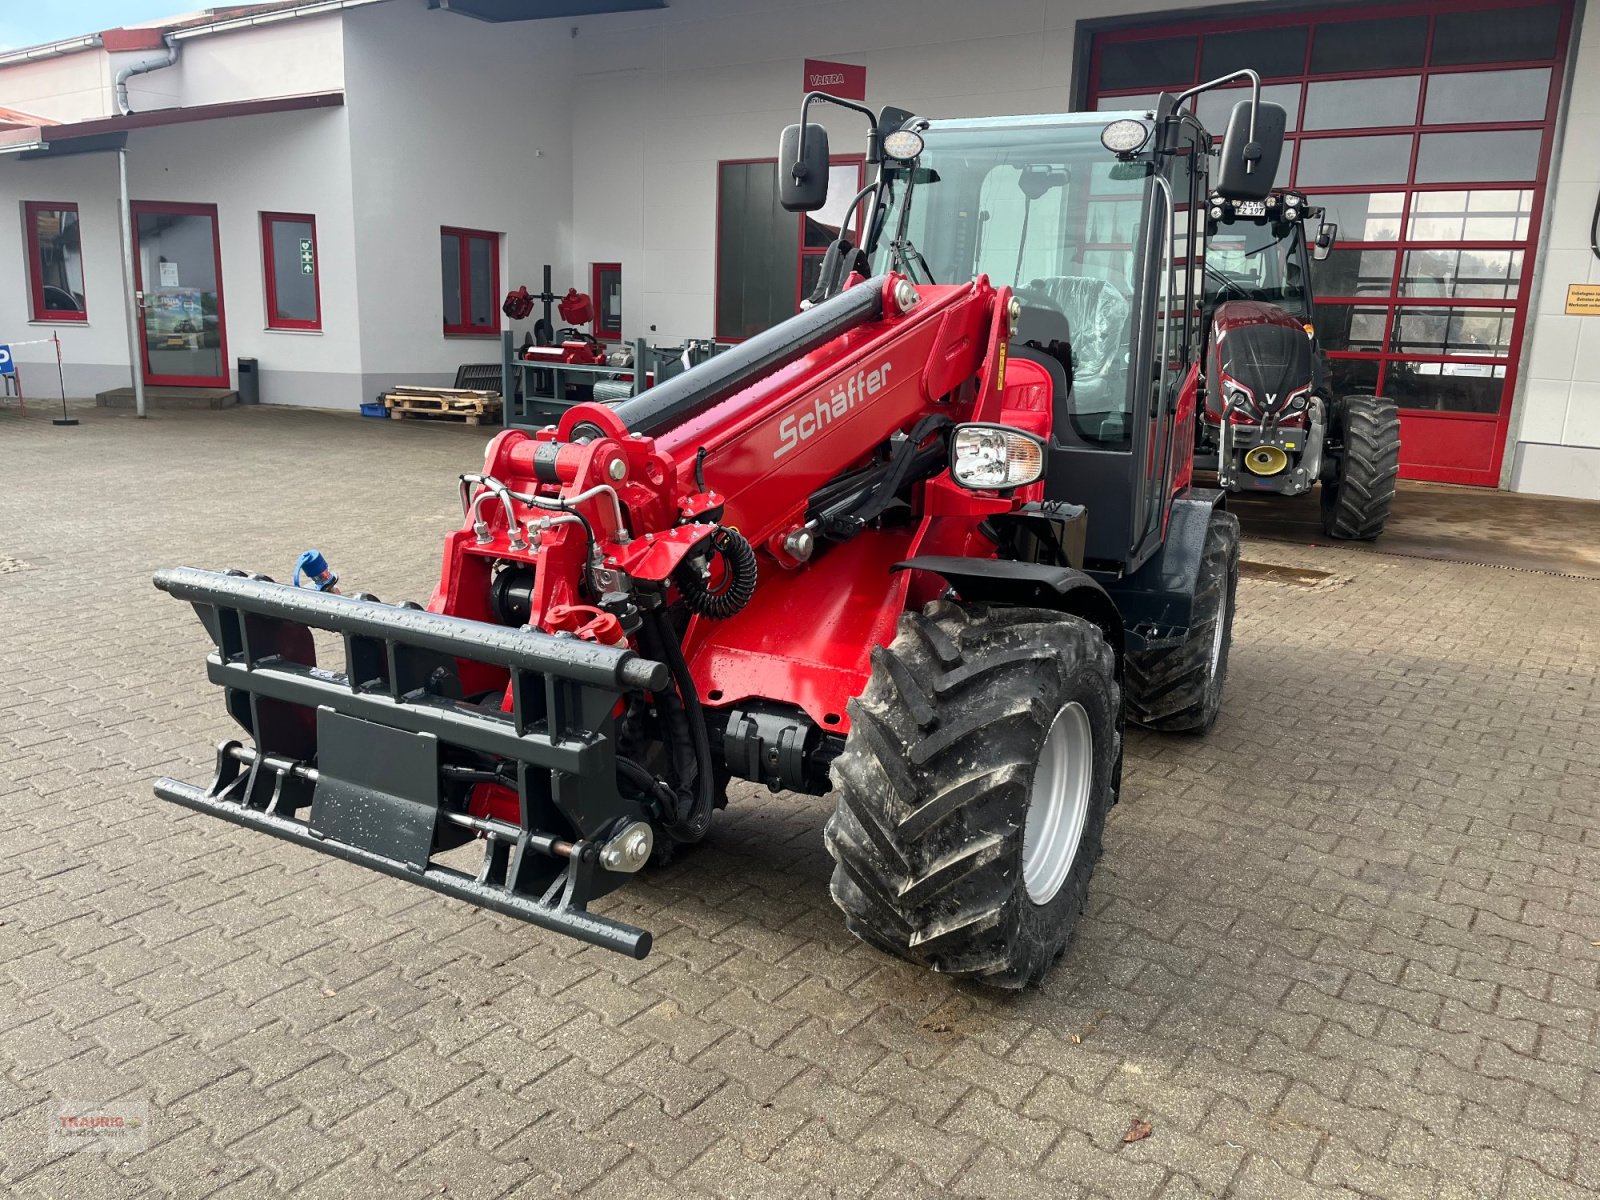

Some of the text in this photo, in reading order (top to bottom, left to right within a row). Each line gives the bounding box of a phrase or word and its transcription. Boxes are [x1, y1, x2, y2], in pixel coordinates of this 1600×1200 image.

[810, 73, 844, 86] VALTRA
[1249, 207, 1265, 215] 197
[773, 362, 892, 460] Schäffer
